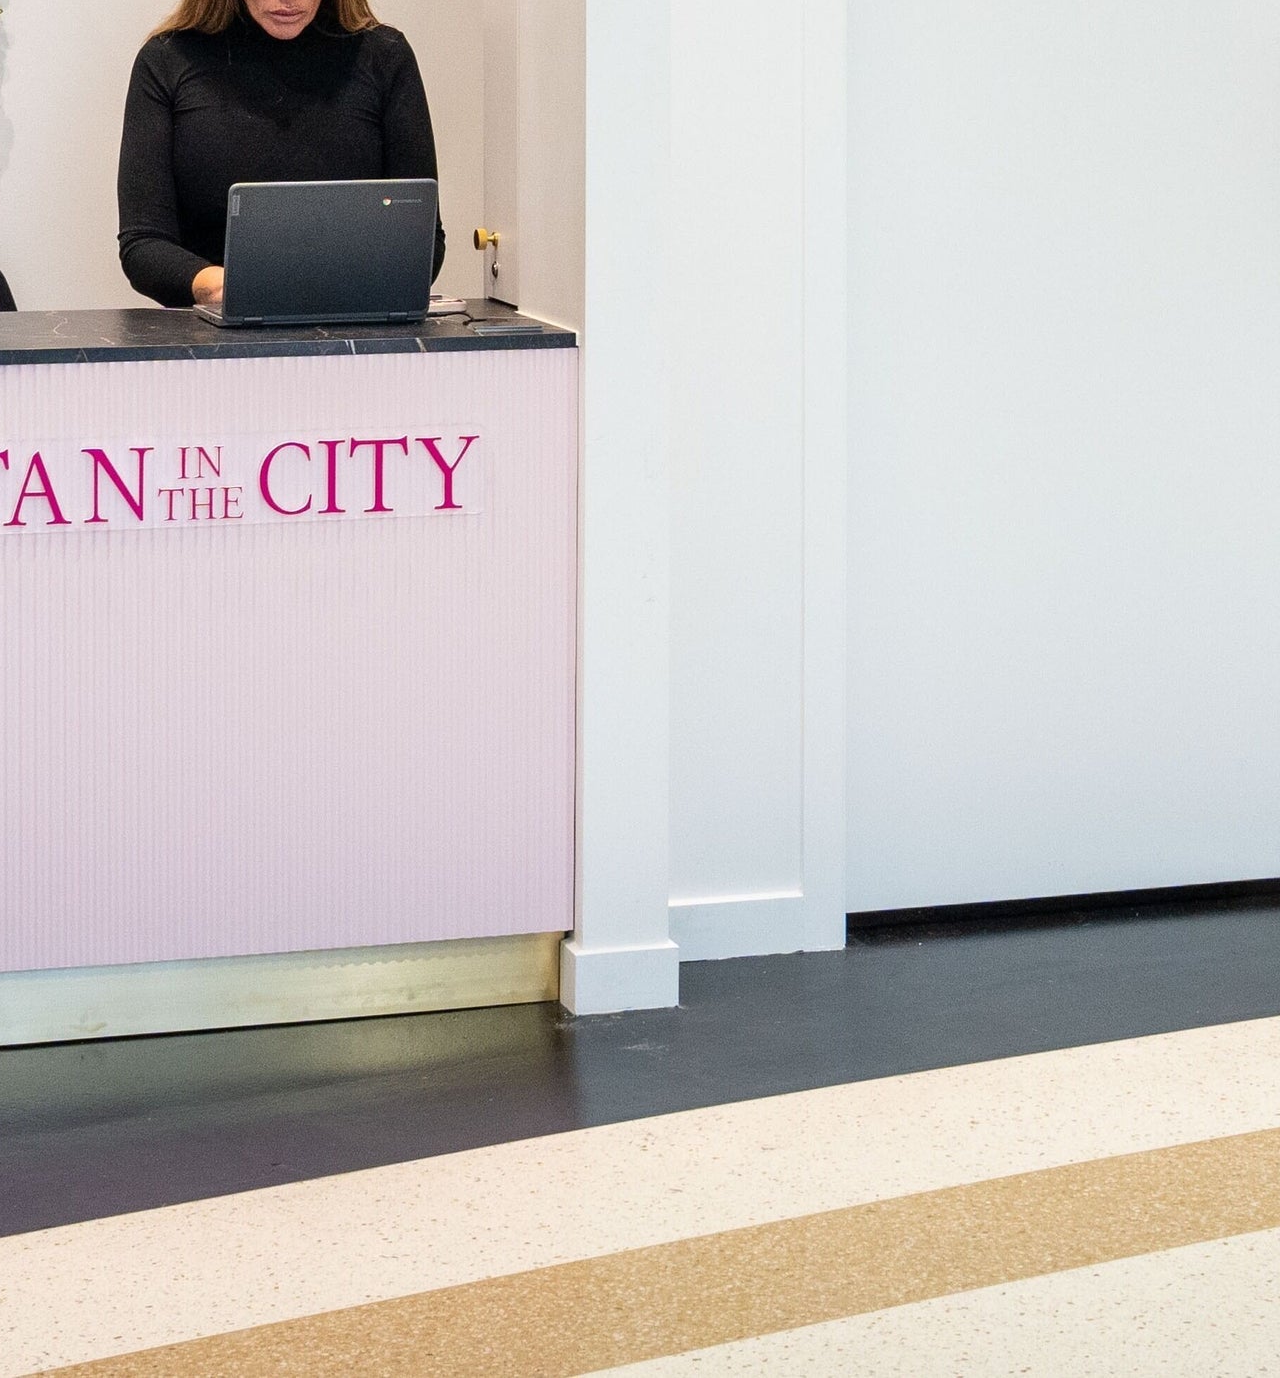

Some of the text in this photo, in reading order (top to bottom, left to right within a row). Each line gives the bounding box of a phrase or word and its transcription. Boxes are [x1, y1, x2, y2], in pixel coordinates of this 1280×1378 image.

[177, 446, 223, 480] IN
[257, 434, 480, 516] CITY
[157, 486, 244, 521] THE
